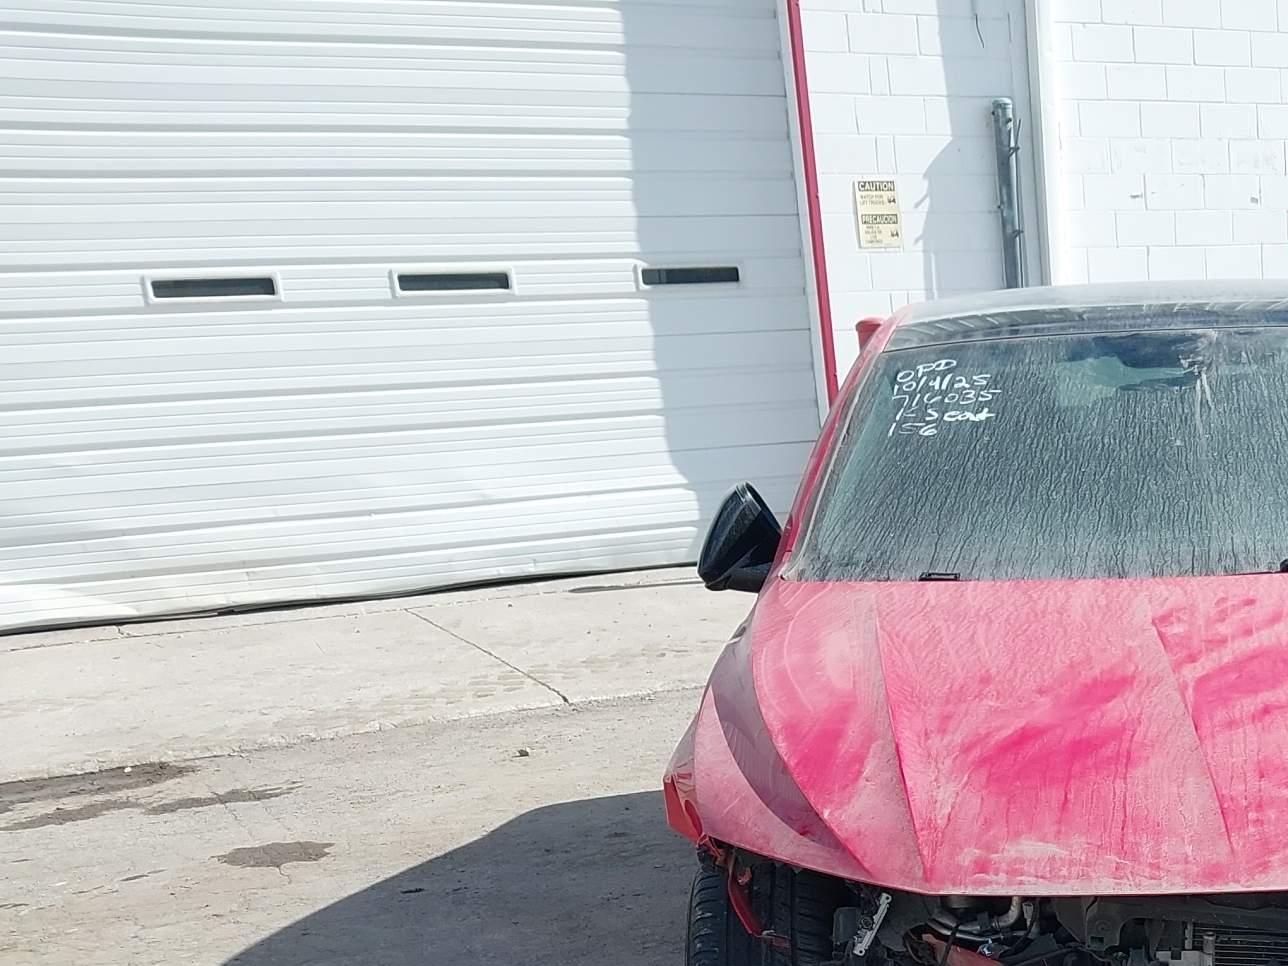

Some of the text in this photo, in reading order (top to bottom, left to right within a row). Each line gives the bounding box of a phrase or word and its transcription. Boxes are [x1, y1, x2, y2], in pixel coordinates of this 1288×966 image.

[859, 182, 894, 191] CAUTION
[897, 359, 957, 382] OPD
[893, 373, 991, 395] 10/4/25
[888, 422, 938, 437] 156
